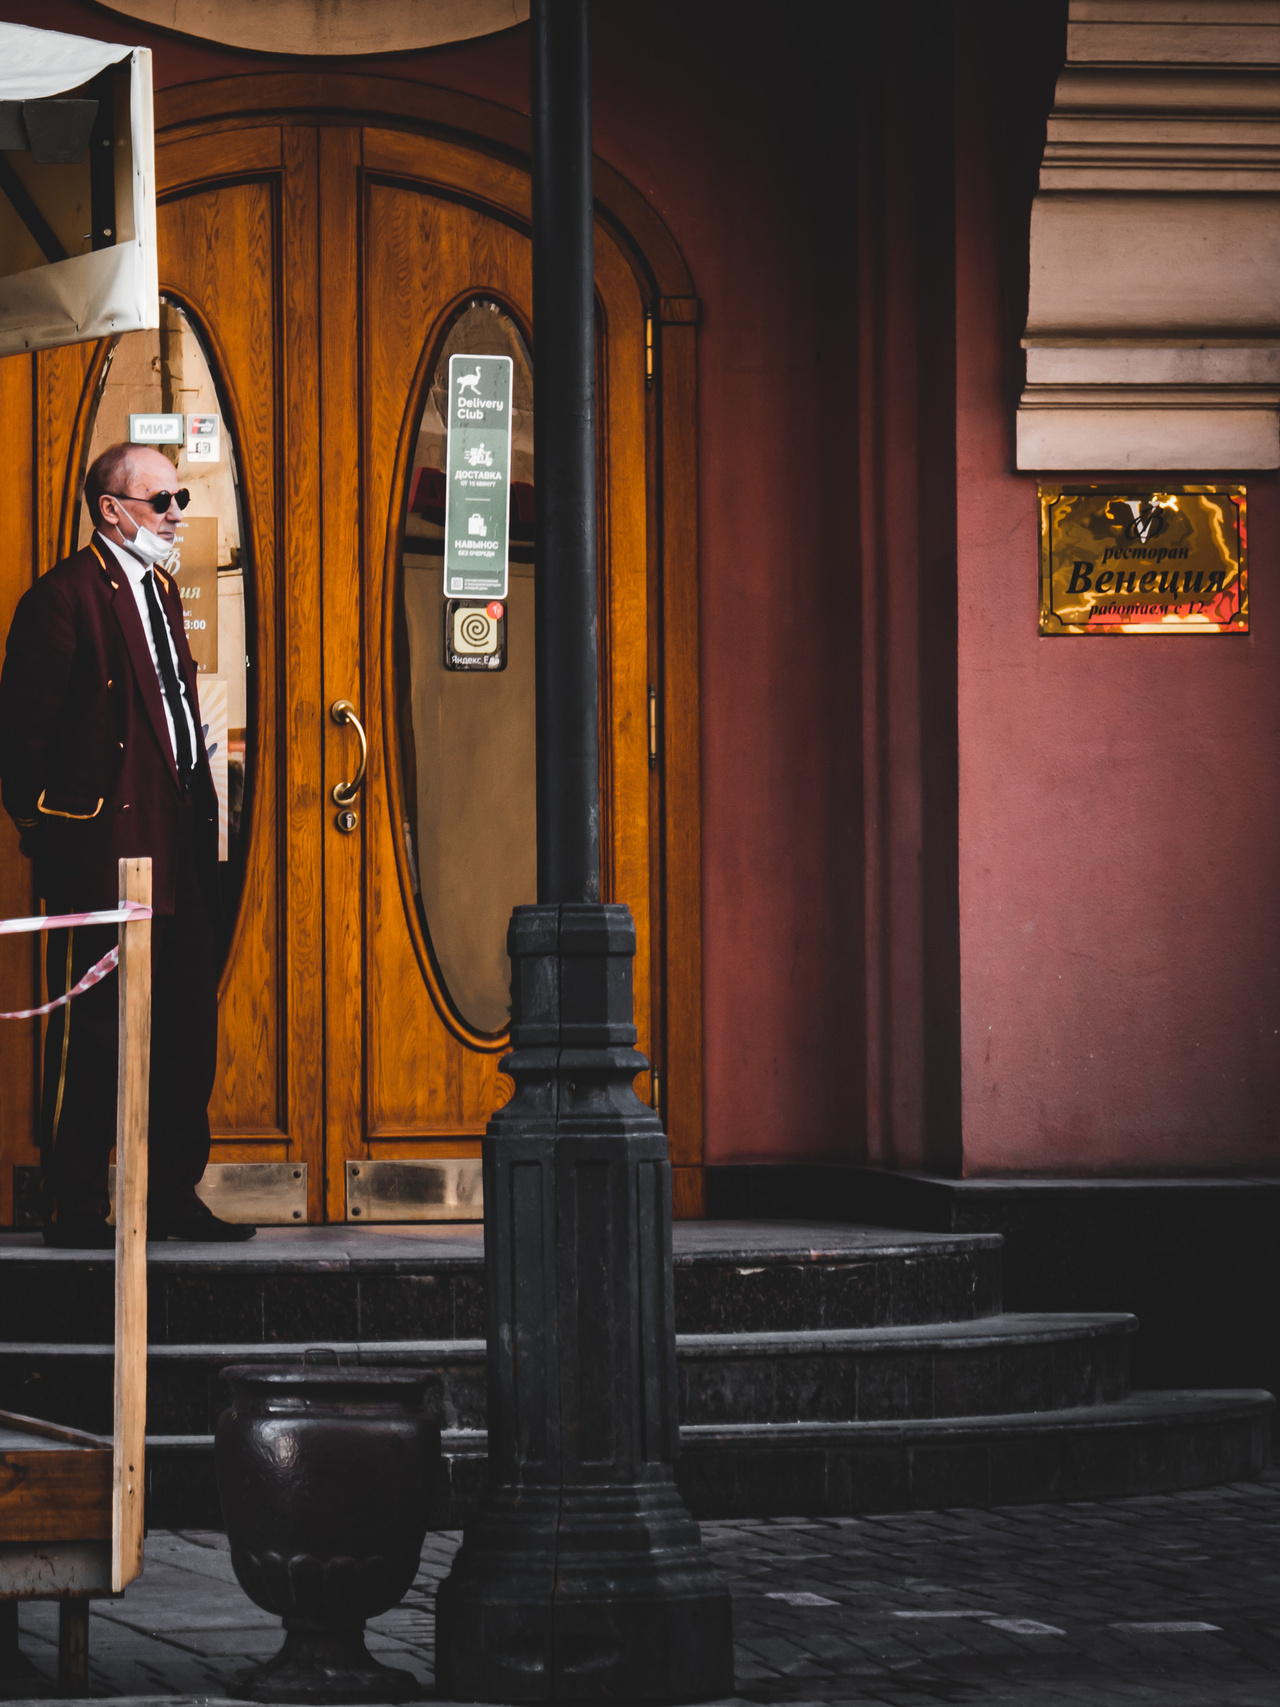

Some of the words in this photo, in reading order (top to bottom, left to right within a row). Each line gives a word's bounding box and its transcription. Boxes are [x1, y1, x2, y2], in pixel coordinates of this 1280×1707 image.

[457, 397, 504, 411] Delivery
[457, 409, 484, 420] Club
[140, 424, 174, 434] МИР
[455, 470, 502, 480] ДОСТАВКА
[1102, 547, 1190, 564] ресторан
[1066, 561, 1227, 600] Венеция
[1089, 601, 1169, 619] работаем
[183, 619, 207, 630] 3:00
